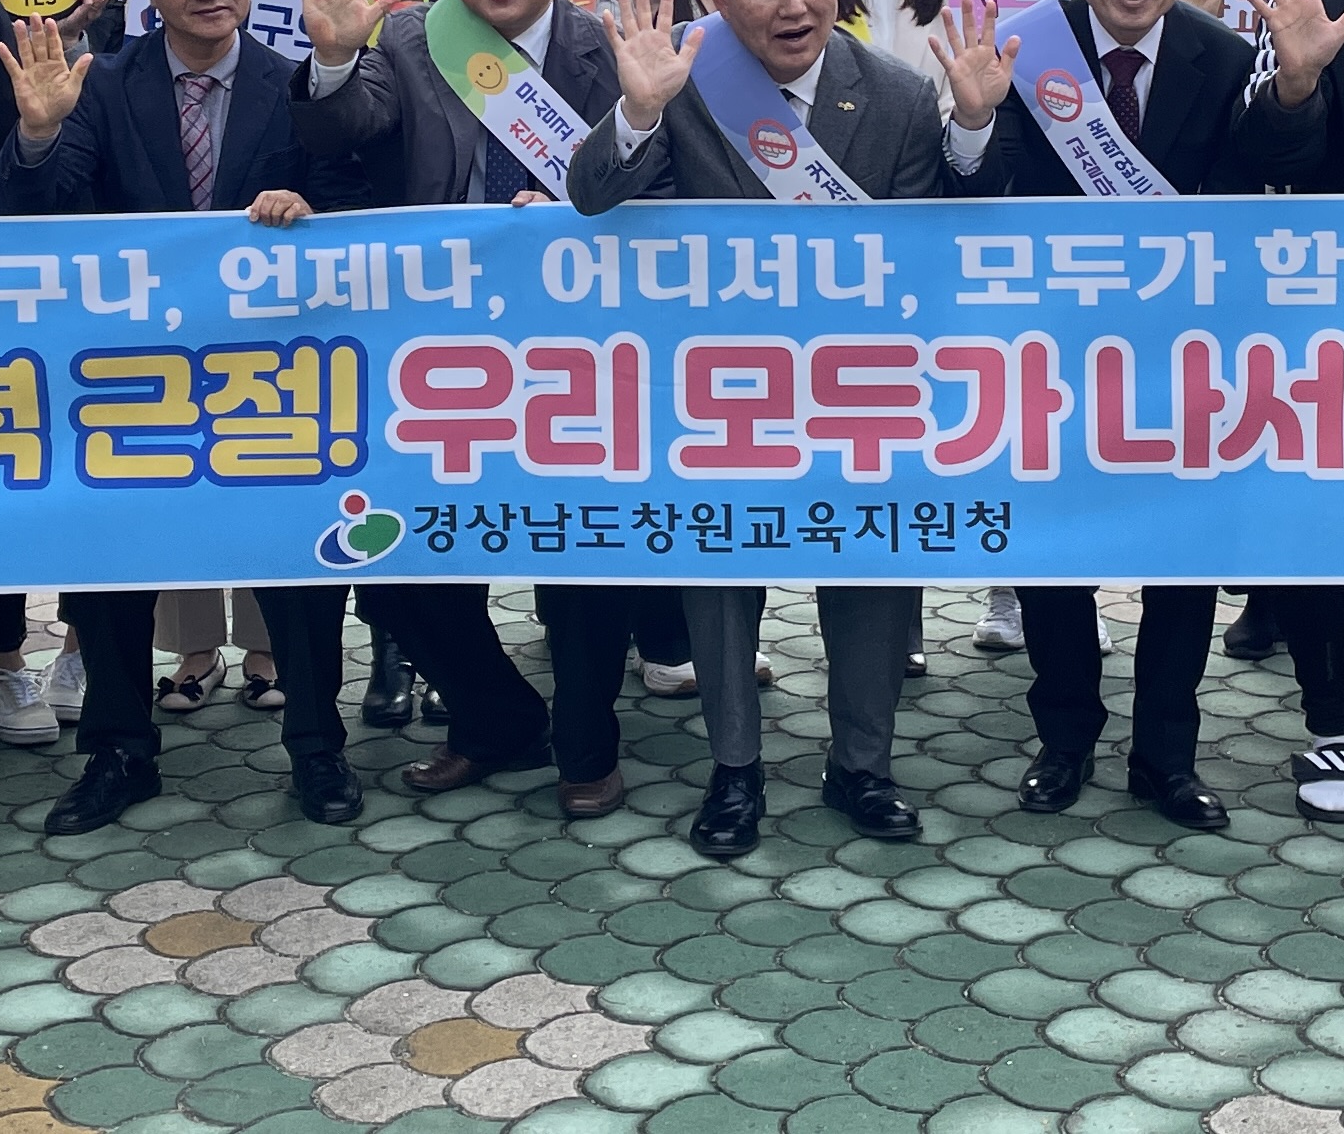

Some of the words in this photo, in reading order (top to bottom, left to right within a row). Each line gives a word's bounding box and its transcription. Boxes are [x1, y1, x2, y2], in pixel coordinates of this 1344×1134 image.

[515, 81, 575, 142] 무심코
[1086, 117, 1154, 196] 폭력없는
[218, 238, 505, 322] 언제나,
[541, 232, 919, 319] 어디서나,
[956, 231, 1224, 310] 모두가
[73, 341, 364, 486] 근절!
[391, 338, 646, 479] 우리
[676, 336, 1058, 471] 모두가
[411, 499, 1014, 555] 경상남도창원교육지원청
